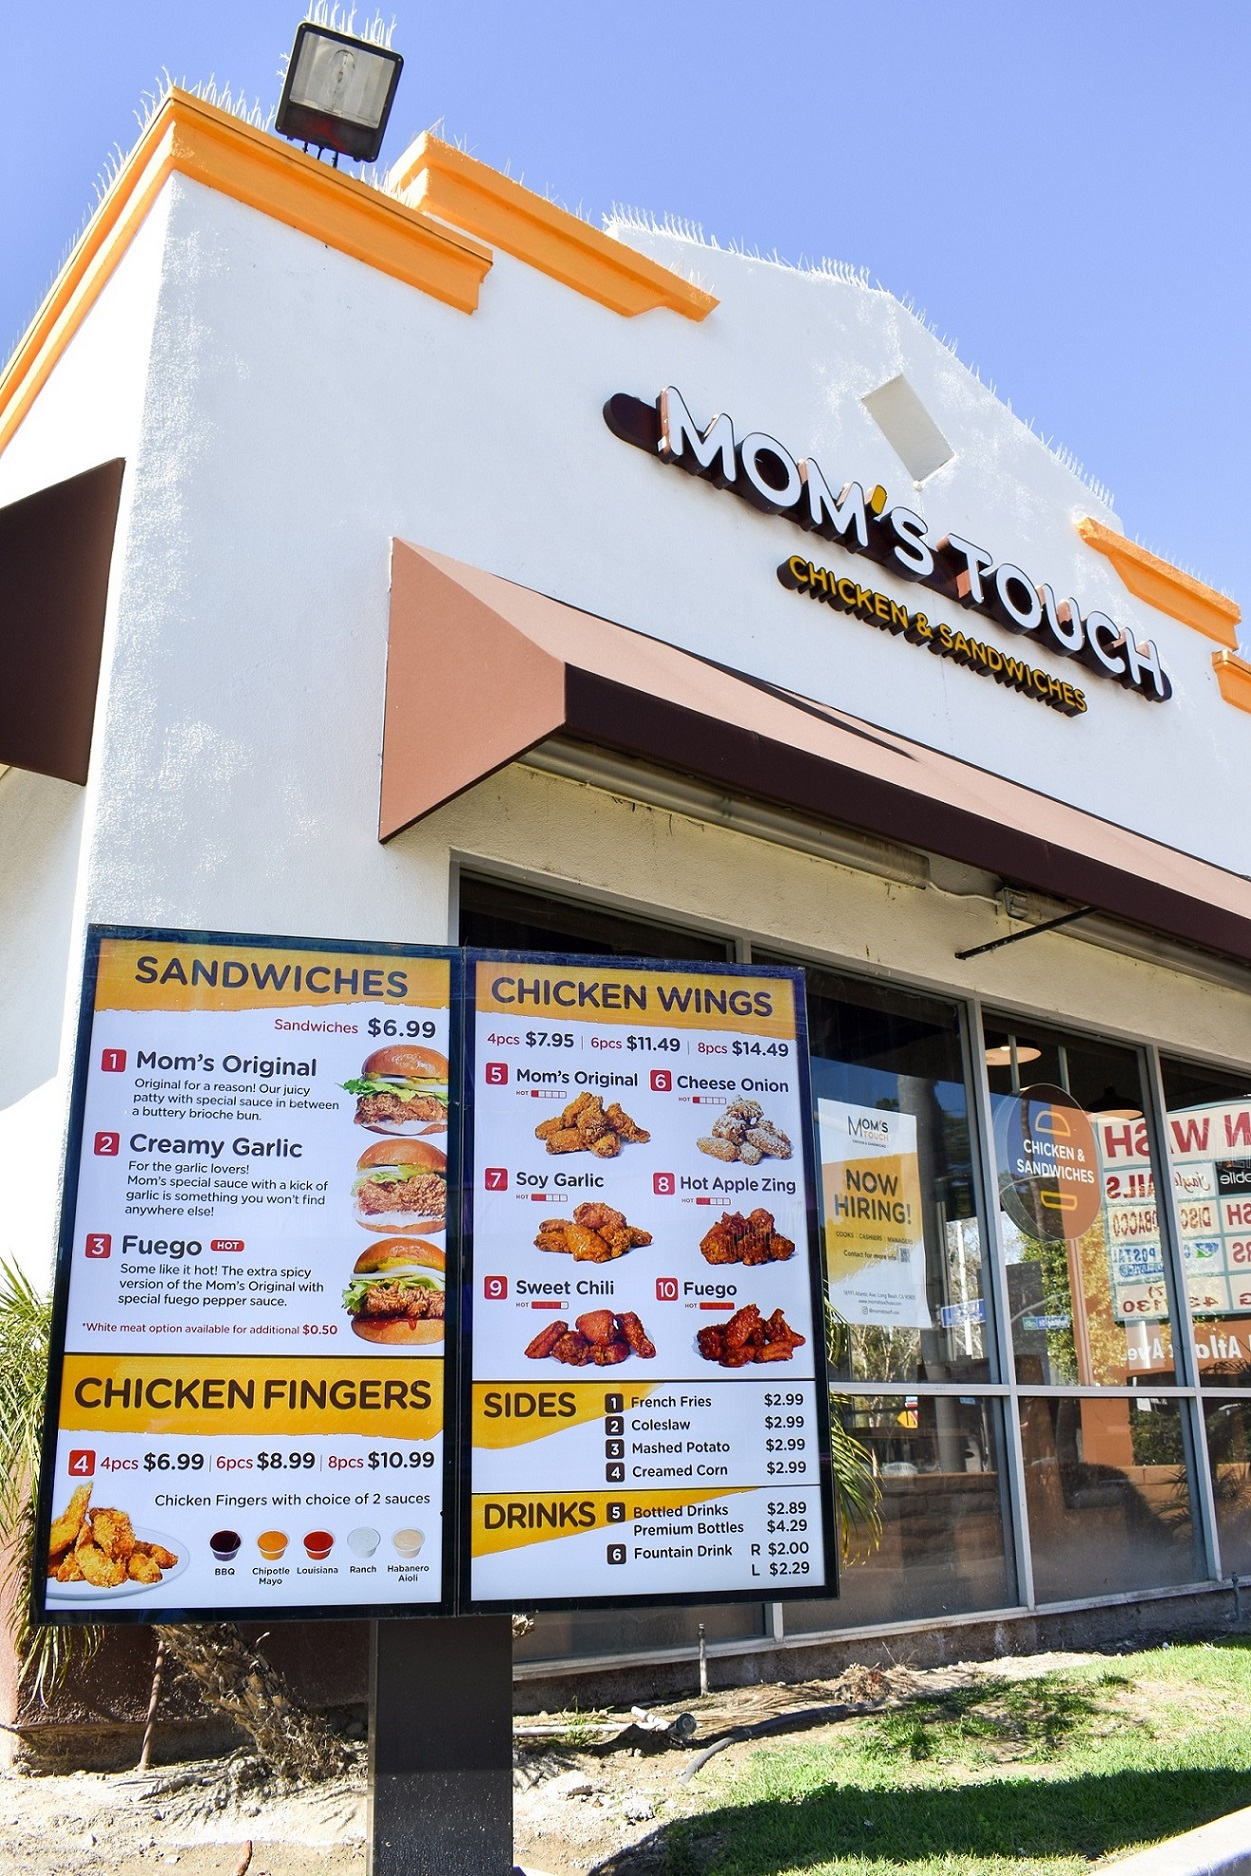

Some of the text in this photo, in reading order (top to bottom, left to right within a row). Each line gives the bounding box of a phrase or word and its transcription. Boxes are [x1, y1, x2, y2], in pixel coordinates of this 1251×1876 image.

[659, 385, 1169, 699] MOM'S TOUCH
[788, 555, 1088, 713] CHICKEN & SANDWICHES
[135, 956, 408, 998] SANDWICHES
[491, 977, 773, 1018] CHICKEN WINGS
[274, 1017, 436, 1039] Sandwiches $6.99
[487, 1031, 789, 1058] 4pcs $7.95 6pcs $11.49 8pcs $14.49
[109, 1050, 317, 1079] 1 Mom's Original
[490, 1067, 638, 1088] 5 Mom's Original
[655, 1073, 789, 1093] 6 Cheese Onion
[134, 1078, 311, 1097] Original for a reason! Our juicy
[132, 1106, 262, 1121] a buttery brioche bun.
[847, 1115, 889, 1138] MOM'S
[862, 1130, 889, 1142] TOUCH
[100, 1133, 303, 1159] 2 Creamy Garlic
[1023, 1138, 1086, 1162] CHICKEN &
[128, 1160, 250, 1175] For the garlic lovers!
[1016, 1158, 1095, 1184] SANDWICHES
[490, 1172, 604, 1189] 7 Soy Garlic
[658, 1176, 796, 1195] 8 Hot Apple Zing
[846, 1168, 898, 1197] NOW
[834, 1194, 912, 1225] HIRING!
[858, 1233, 883, 1242] CASHIERS
[91, 1235, 239, 1260] 3 Fuego HOT
[120, 1263, 312, 1280] Some like it hot! The extra spicy
[489, 1280, 614, 1296] 9 Sweet Chili
[658, 1282, 738, 1299] 10 Fuego
[118, 1293, 287, 1308] special fuego pepper sauce.
[120, 1324, 146, 1333] meat
[148, 1324, 183, 1334] option
[185, 1324, 230, 1334] available
[233, 1324, 247, 1334] for
[250, 1325, 300, 1335] additional
[302, 1324, 338, 1336] $0.50
[74, 1377, 432, 1410] CHICKEN FINGERS
[610, 1393, 804, 1410] 1 French Fries $2.99
[483, 1392, 577, 1418] SIDES
[610, 1415, 805, 1432] 2 Coleslaw $2.99
[610, 1438, 806, 1456] 3 Mashed Potato $2.99
[73, 1451, 435, 1473] 4 4pcs $6.99 6pcs $8.99 8pcs $10.99
[610, 1461, 807, 1479] 4 Creamed Corn $2.99
[155, 1493, 431, 1508] Chicken Fingers with choice of 2 sauces
[484, 1501, 596, 1530] DRINKS
[611, 1501, 807, 1519] 5 Bottled Drinks $2.89
[634, 1519, 808, 1537] Premium Bottles $4.29
[612, 1541, 809, 1561] 6 Fountain Drink R $2.00
[215, 1568, 236, 1576] BBQ
[252, 1567, 290, 1577] Chipotle
[296, 1566, 339, 1575] Louisiana
[350, 1565, 377, 1574] Ranch
[387, 1565, 430, 1573] Habanero
[398, 1574, 418, 1582] Aioli
[752, 1561, 810, 1577] L $2.29
[259, 1577, 283, 1587] Mayo
